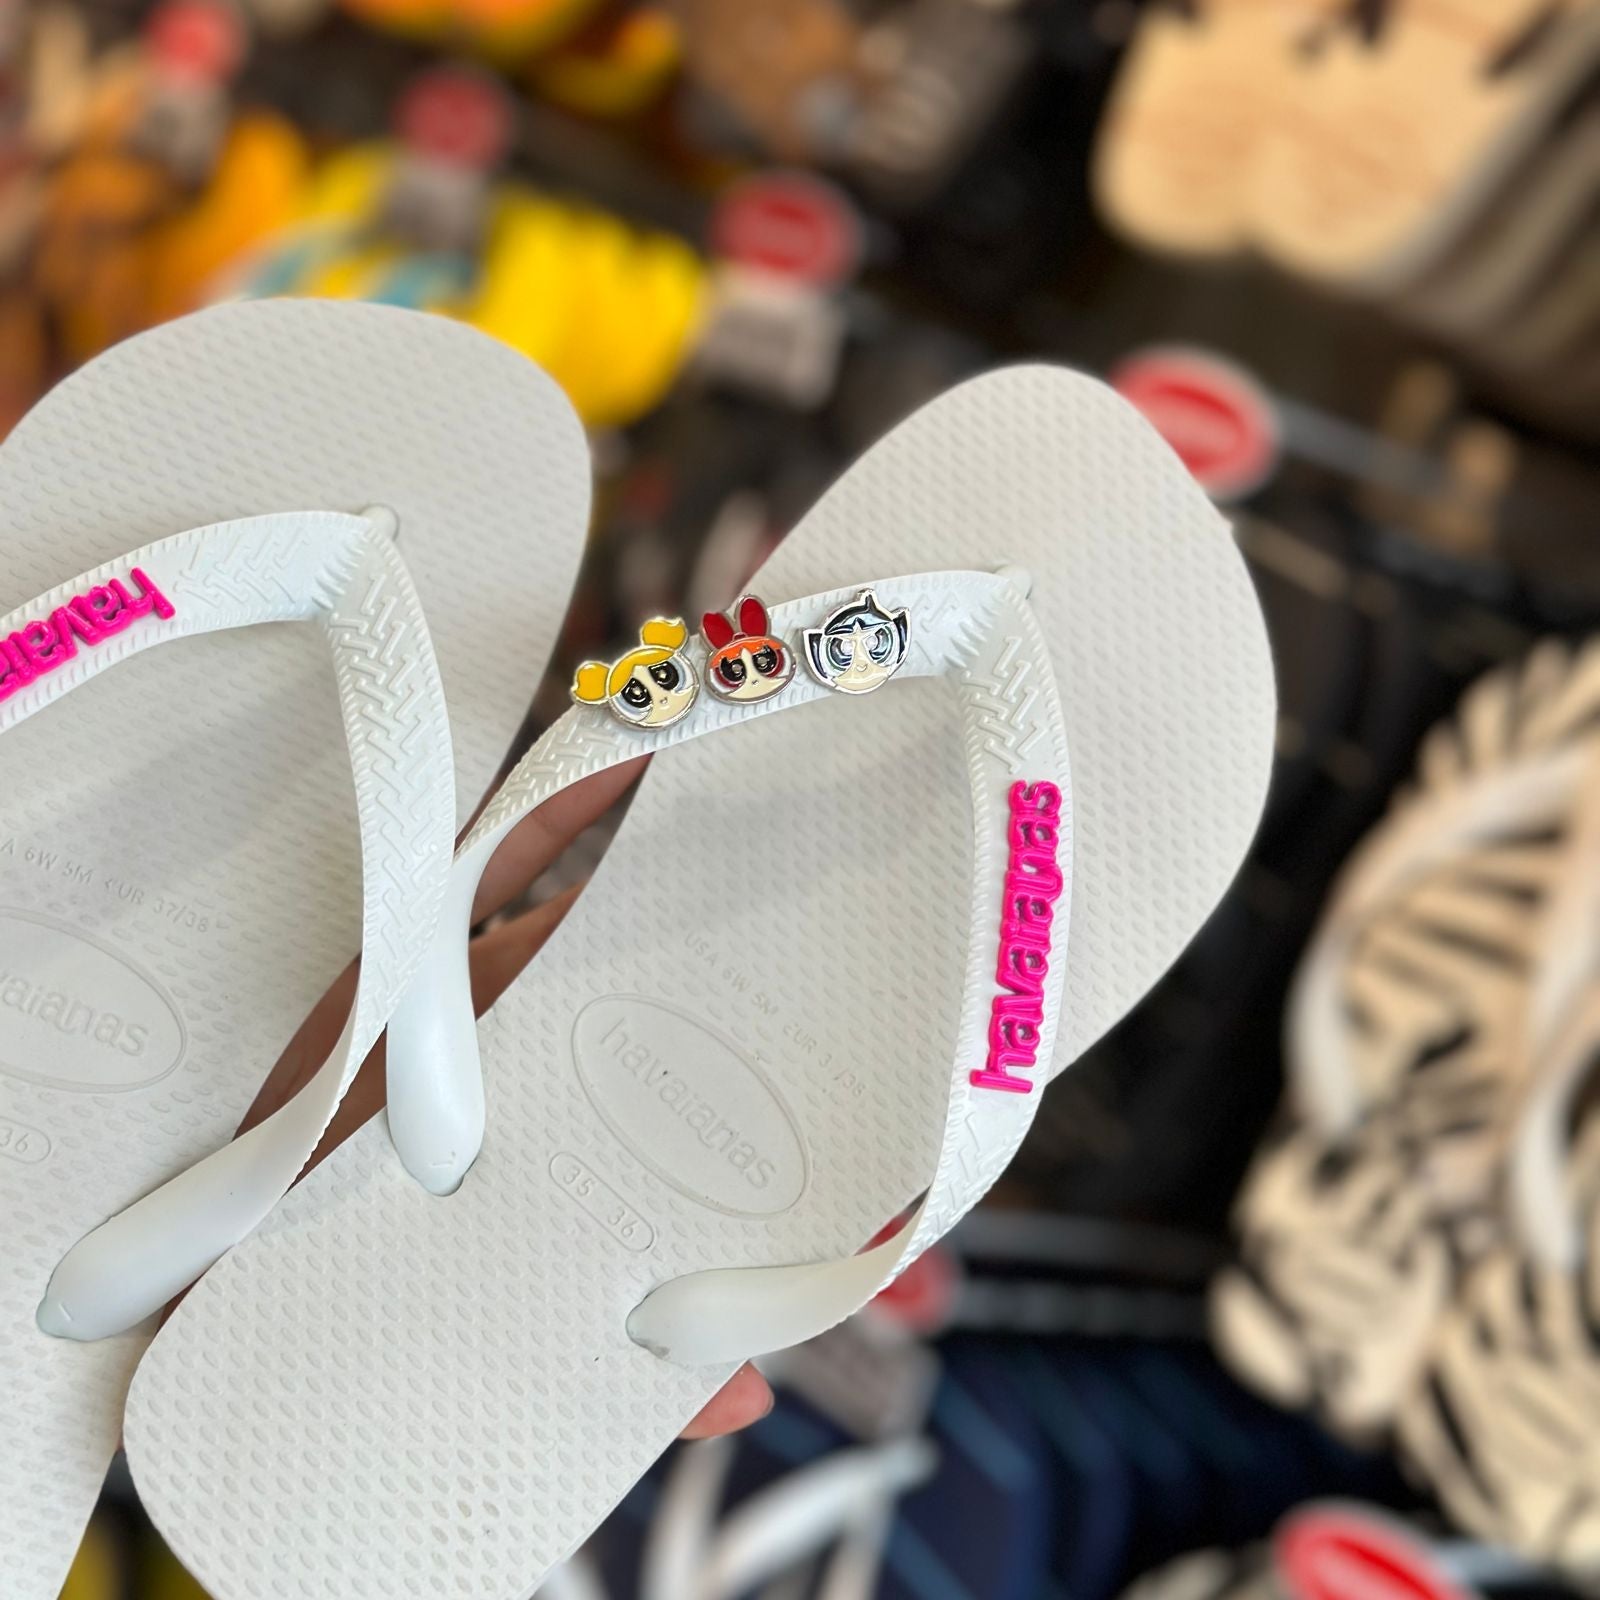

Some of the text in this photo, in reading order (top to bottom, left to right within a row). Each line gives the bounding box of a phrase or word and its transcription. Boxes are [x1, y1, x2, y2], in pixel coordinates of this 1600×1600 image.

[684, 930, 720, 968] USA
[818, 1052, 867, 1098] 3/38
[969, 780, 1063, 1094] havaianas
[599, 1016, 777, 1190] havaianas
[562, 1167, 639, 1238] 35 36
